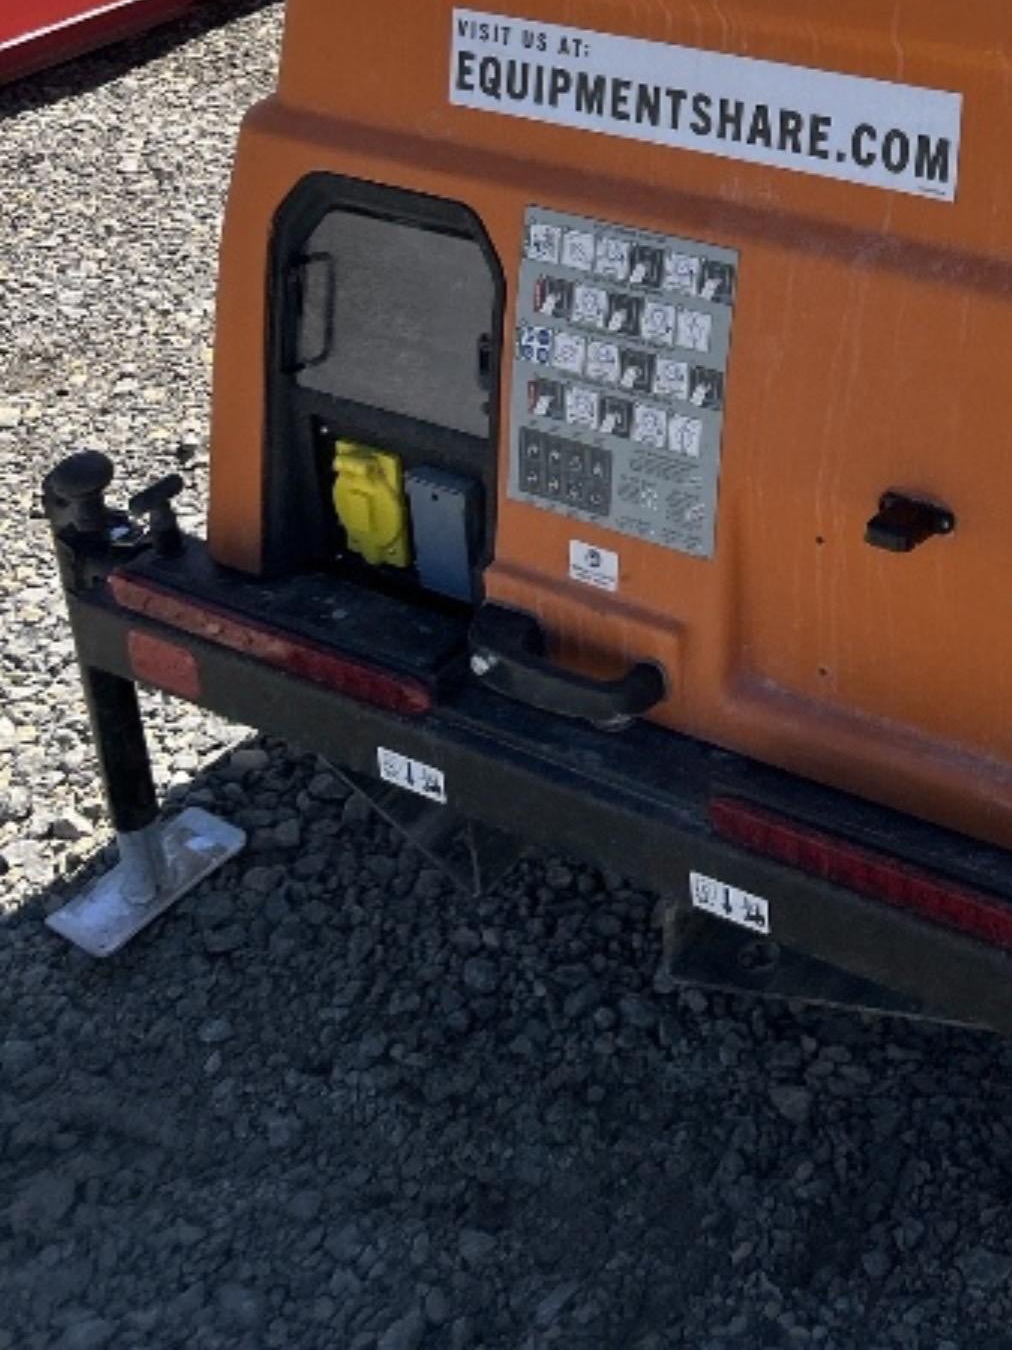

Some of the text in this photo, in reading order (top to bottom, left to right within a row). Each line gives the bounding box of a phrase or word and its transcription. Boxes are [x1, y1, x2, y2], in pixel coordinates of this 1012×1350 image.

[457, 16, 591, 58] VISIT US AT:
[455, 48, 950, 184] EQUIPMENTSHARE.COM
